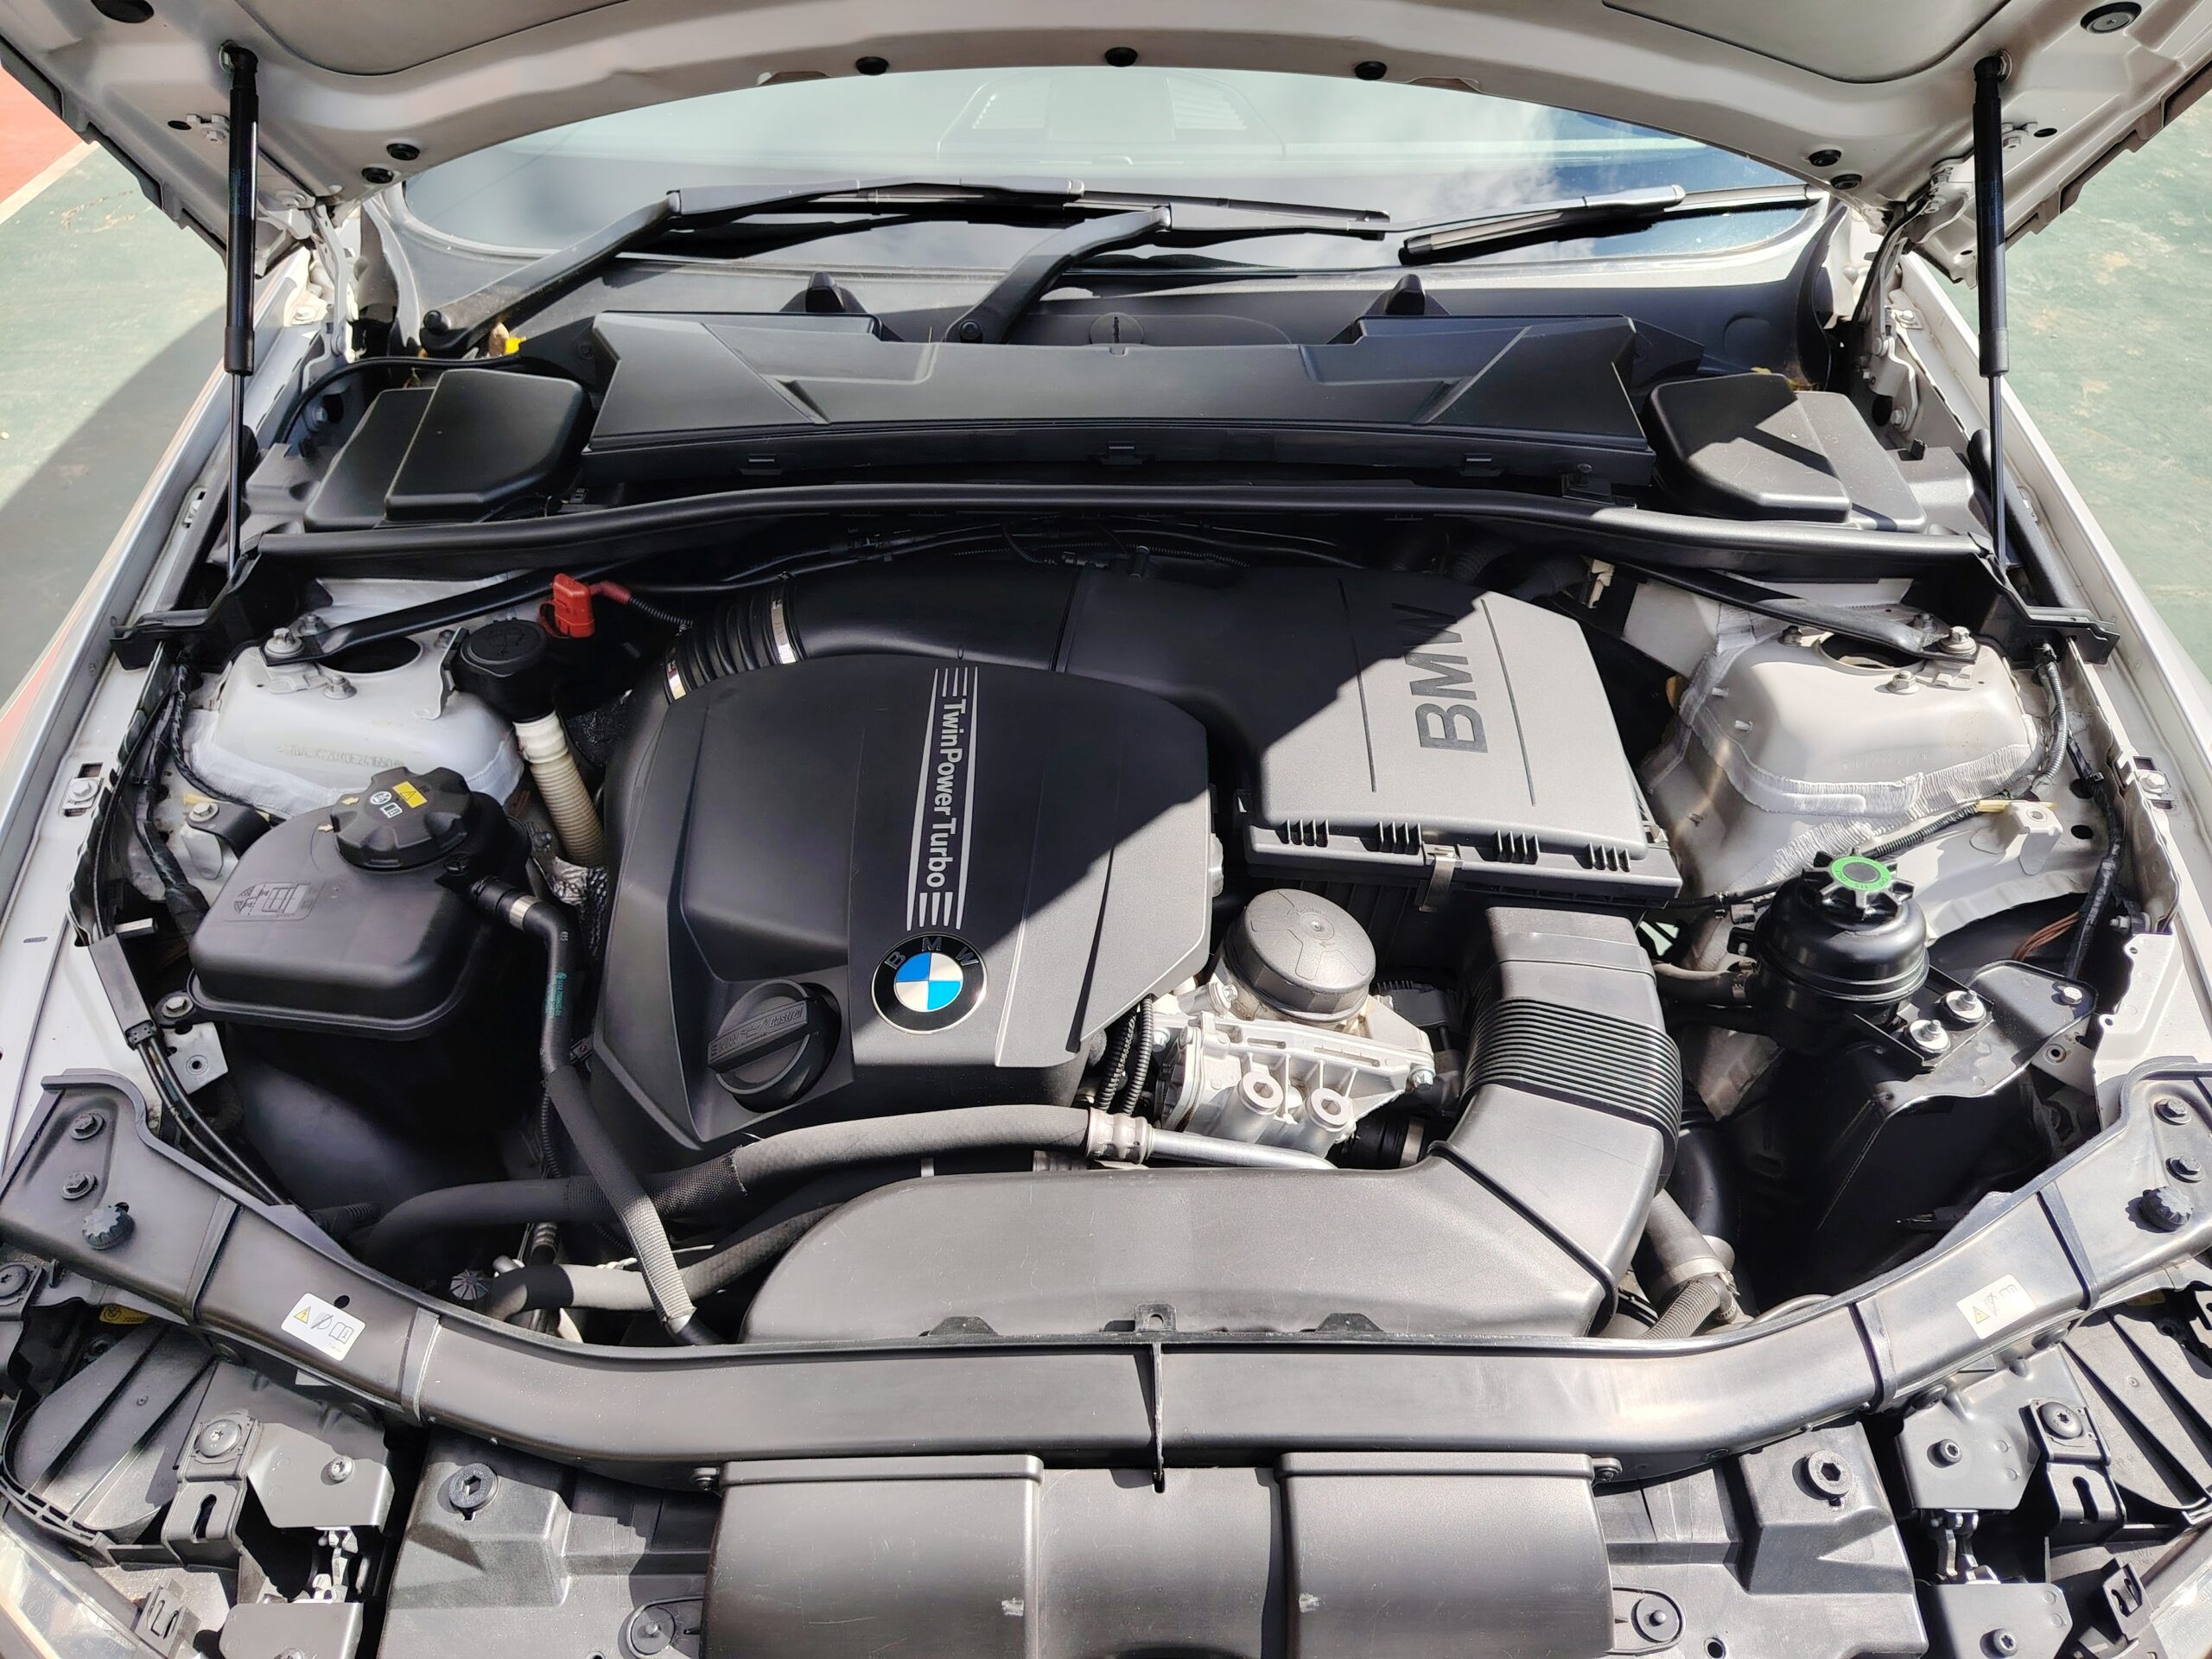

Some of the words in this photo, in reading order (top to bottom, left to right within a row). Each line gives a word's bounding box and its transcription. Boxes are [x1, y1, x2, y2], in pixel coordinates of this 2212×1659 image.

[1390, 602, 1489, 754] BMW
[932, 698, 967, 816] TwinPower
[926, 817, 957, 889] Turbo
[884, 937, 980, 970] BMW
[769, 1007, 804, 1027] Castrol
